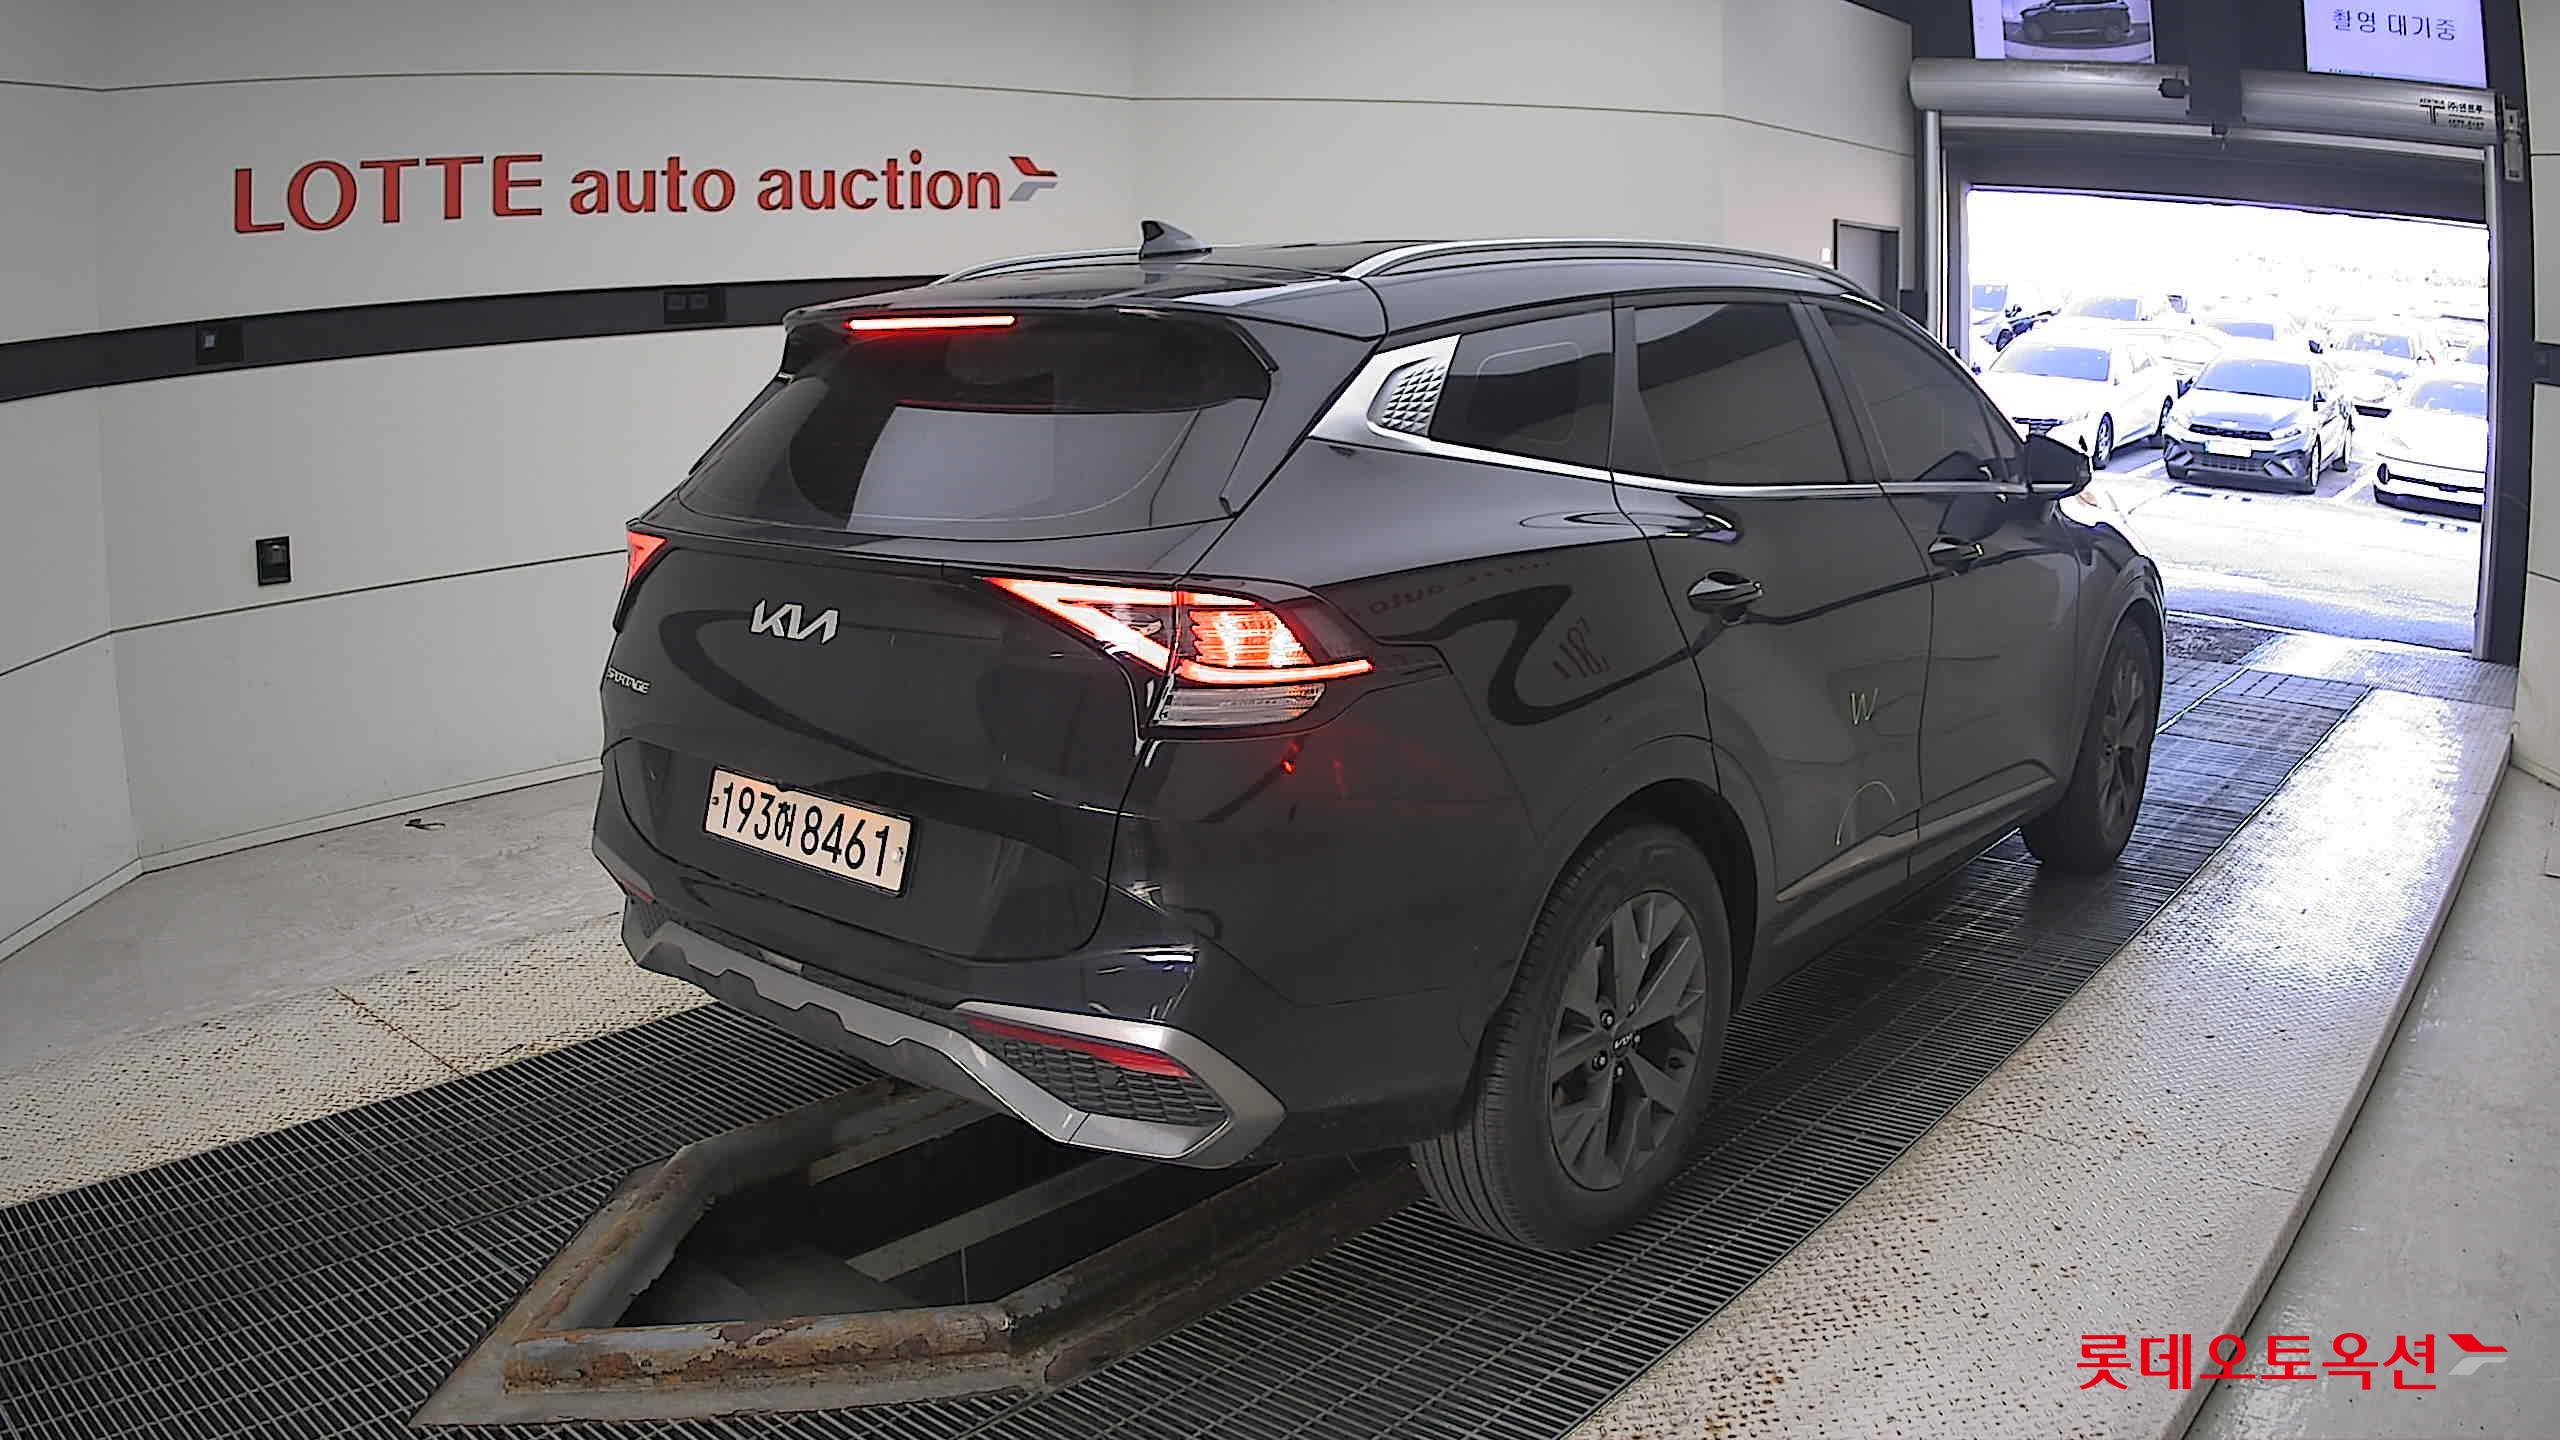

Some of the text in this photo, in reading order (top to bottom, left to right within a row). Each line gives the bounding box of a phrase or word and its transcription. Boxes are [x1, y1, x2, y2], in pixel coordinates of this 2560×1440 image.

[2388, 14, 2455, 41] 대기중
[233, 149, 1003, 234] LOTTE auto auction
[750, 599, 839, 645] KIA
